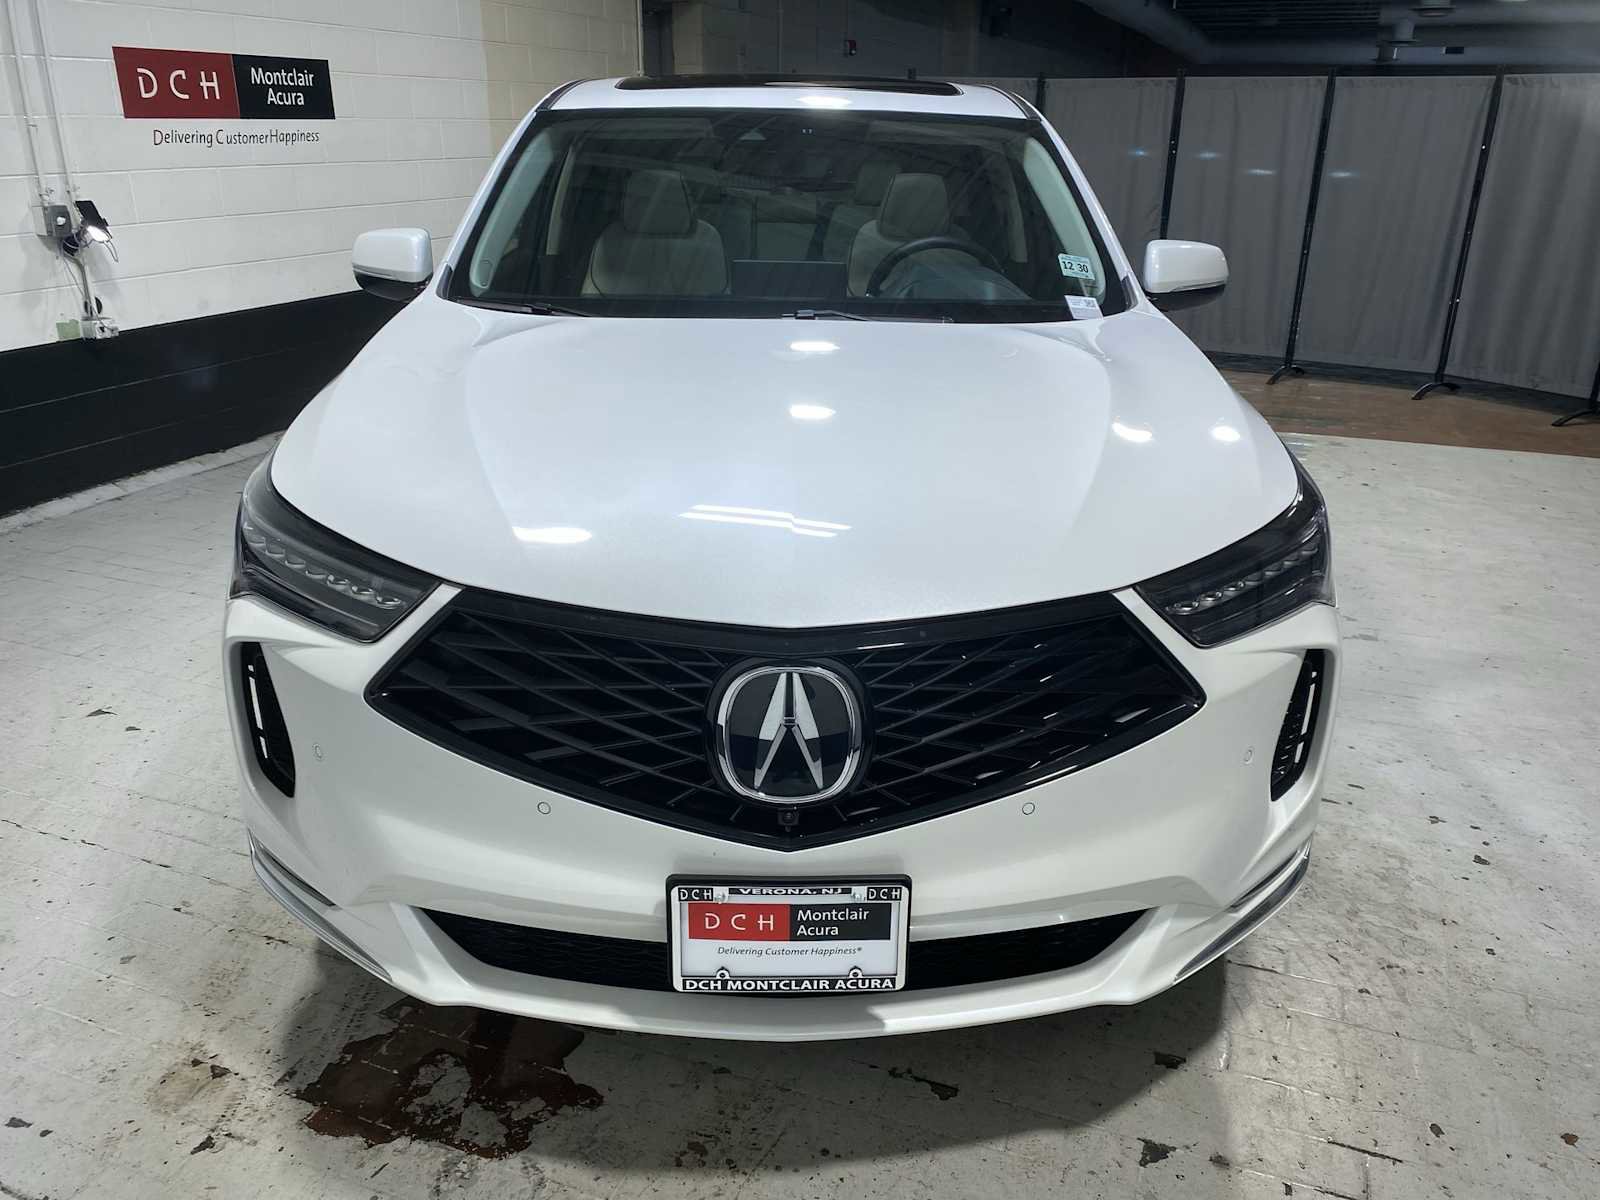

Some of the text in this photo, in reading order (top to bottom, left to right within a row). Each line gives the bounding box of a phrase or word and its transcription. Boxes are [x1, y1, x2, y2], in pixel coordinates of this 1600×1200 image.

[136, 67, 220, 100] DCH
[250, 67, 315, 87] Montclair
[267, 88, 305, 106] Acura
[153, 129, 213, 148] Delivering
[1061, 261, 1089, 274] 12 30
[679, 889, 713, 900] DCH
[821, 887, 842, 895] NJ
[868, 888, 901, 900] DCH
[796, 907, 870, 921] Montclair
[704, 912, 774, 932] DCH
[796, 924, 839, 937] Acura
[717, 946, 763, 958] Delivering
[765, 947, 809, 957] Customer
[685, 978, 894, 991] DCH MONTCLAIR ACURA
